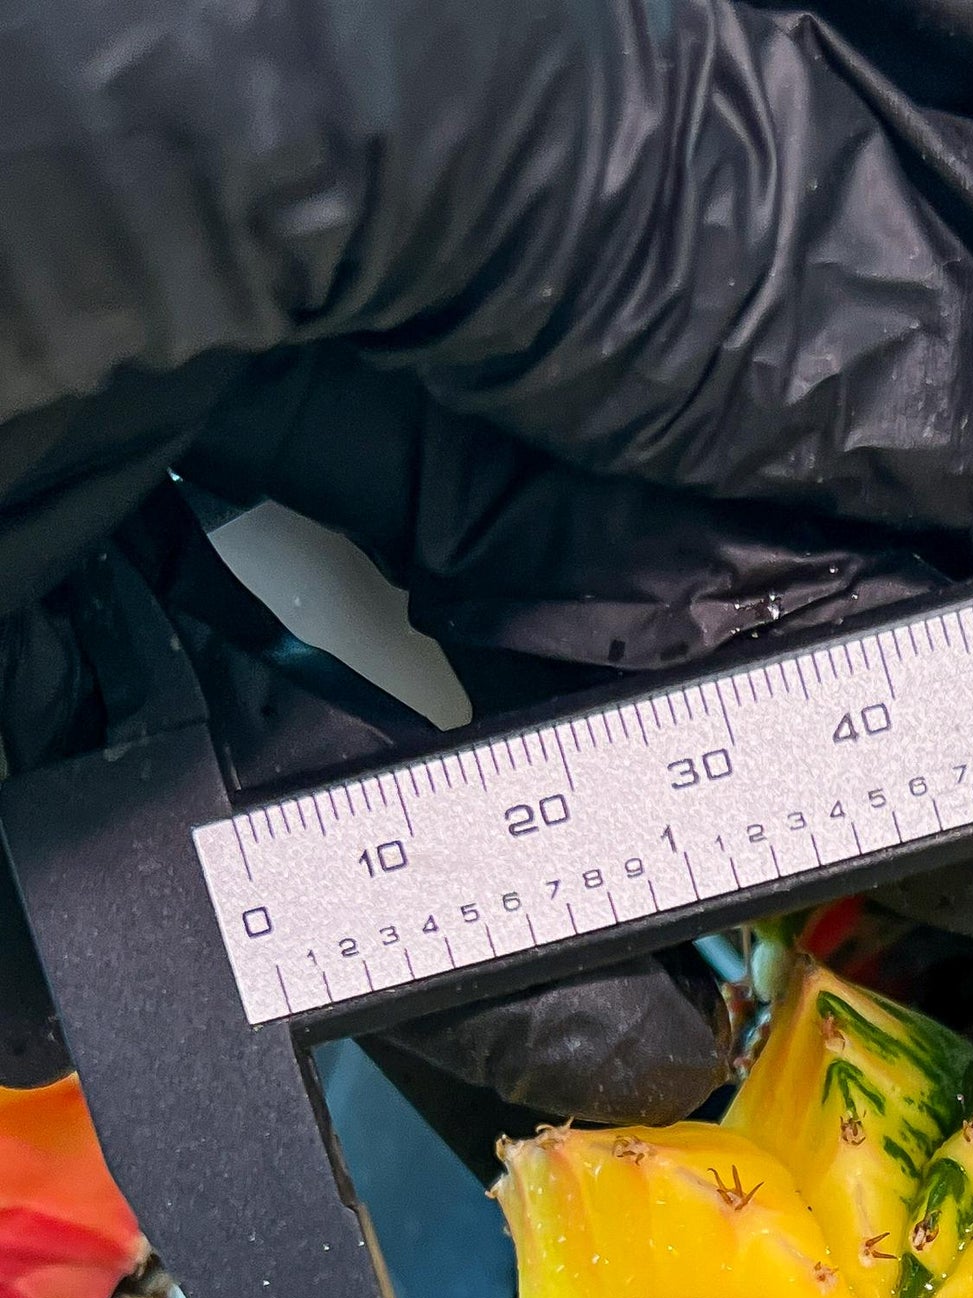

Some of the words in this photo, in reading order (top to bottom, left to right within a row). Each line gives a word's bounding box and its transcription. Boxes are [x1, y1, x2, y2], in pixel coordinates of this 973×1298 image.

[242, 907, 272, 938] 0
[359, 840, 408, 877] 10
[504, 794, 570, 837] 20
[667, 748, 733, 789] 30
[833, 702, 891, 743] 40
[307, 950, 317, 965] 1
[339, 938, 359, 958] 2
[379, 926, 400, 946] 3
[422, 915, 438, 933] 4
[460, 903, 479, 923] 5
[502, 891, 521, 912] 6
[546, 880, 560, 899] 7
[582, 869, 604, 889] 8
[624, 858, 644, 878] 9
[661, 825, 677, 852] 1
[715, 835, 724, 851] 1
[747, 824, 767, 843] 2
[787, 812, 807, 830] 3
[830, 800, 845, 818] 4
[868, 788, 886, 808] 5
[908, 776, 928, 796] 6
[953, 764, 967, 784] 7
